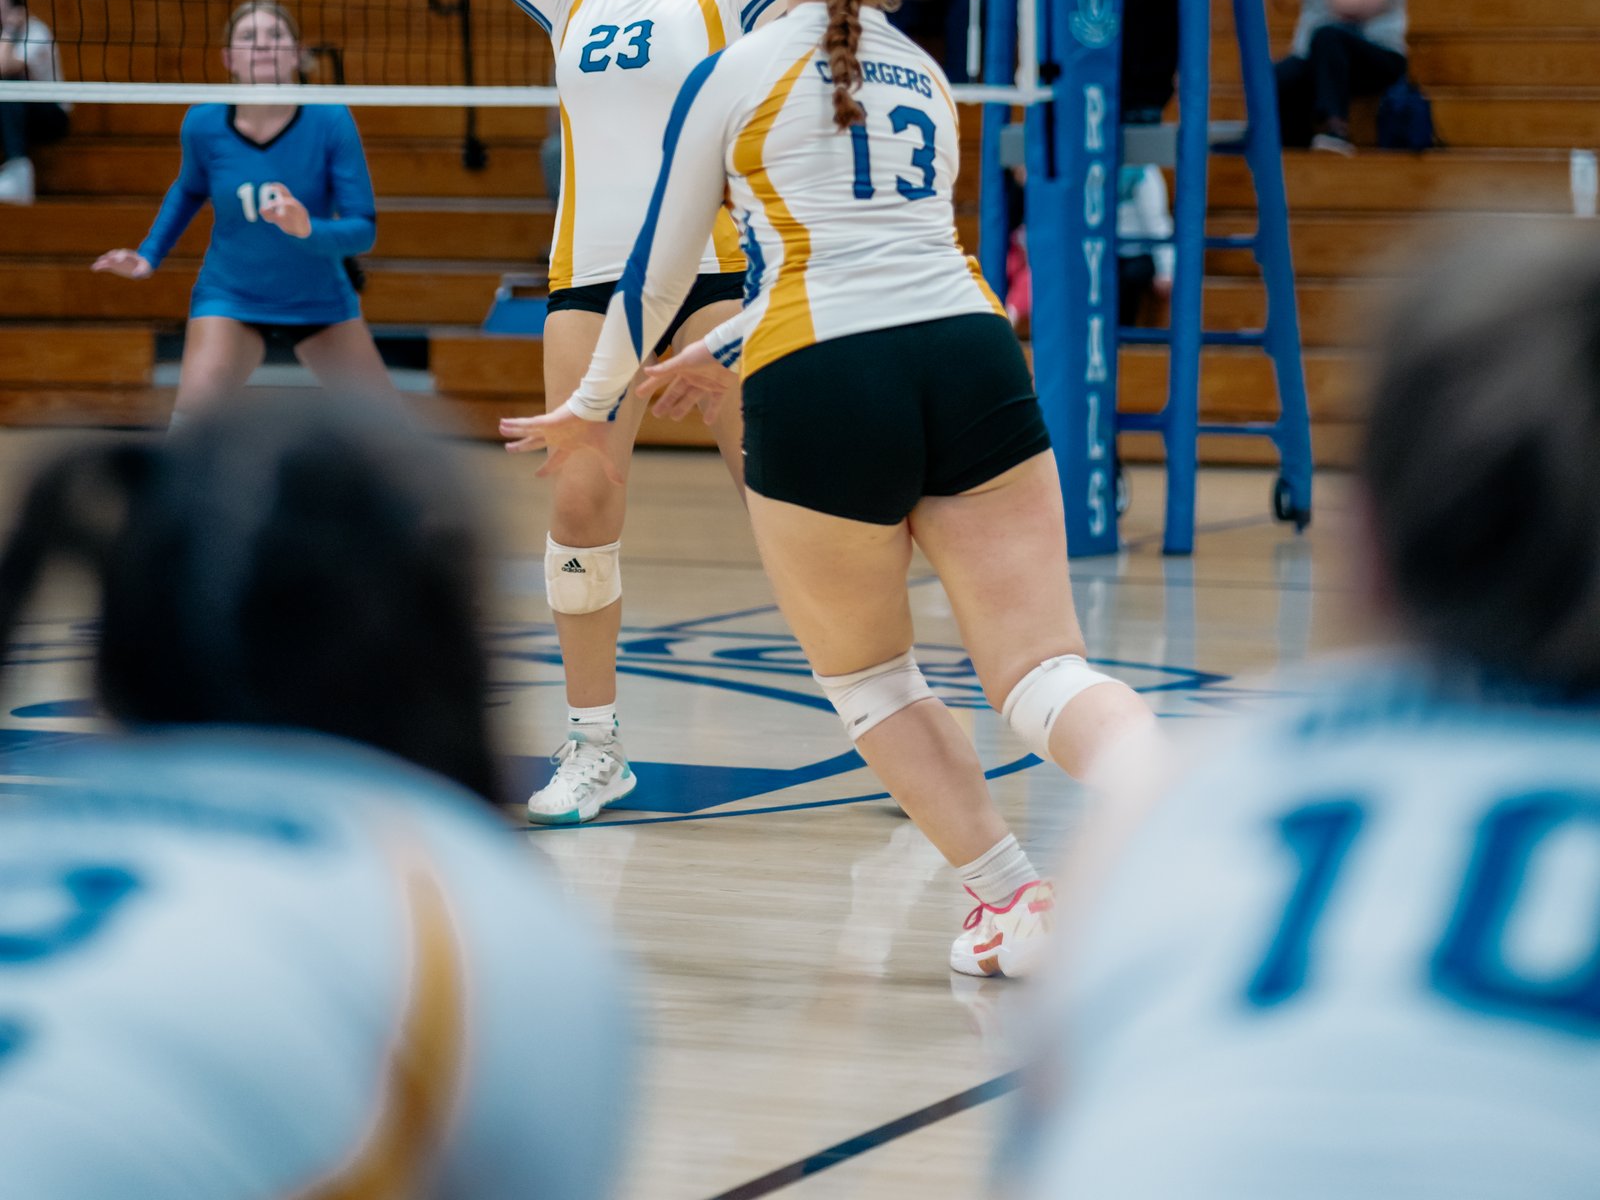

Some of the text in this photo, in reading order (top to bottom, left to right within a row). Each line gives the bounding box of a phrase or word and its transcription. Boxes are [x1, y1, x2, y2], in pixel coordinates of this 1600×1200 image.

[579, 19, 655, 73] 23
[850, 101, 937, 201] 13
[1081, 84, 1107, 538] ROYALS
[1248, 793, 1600, 1036] 10
